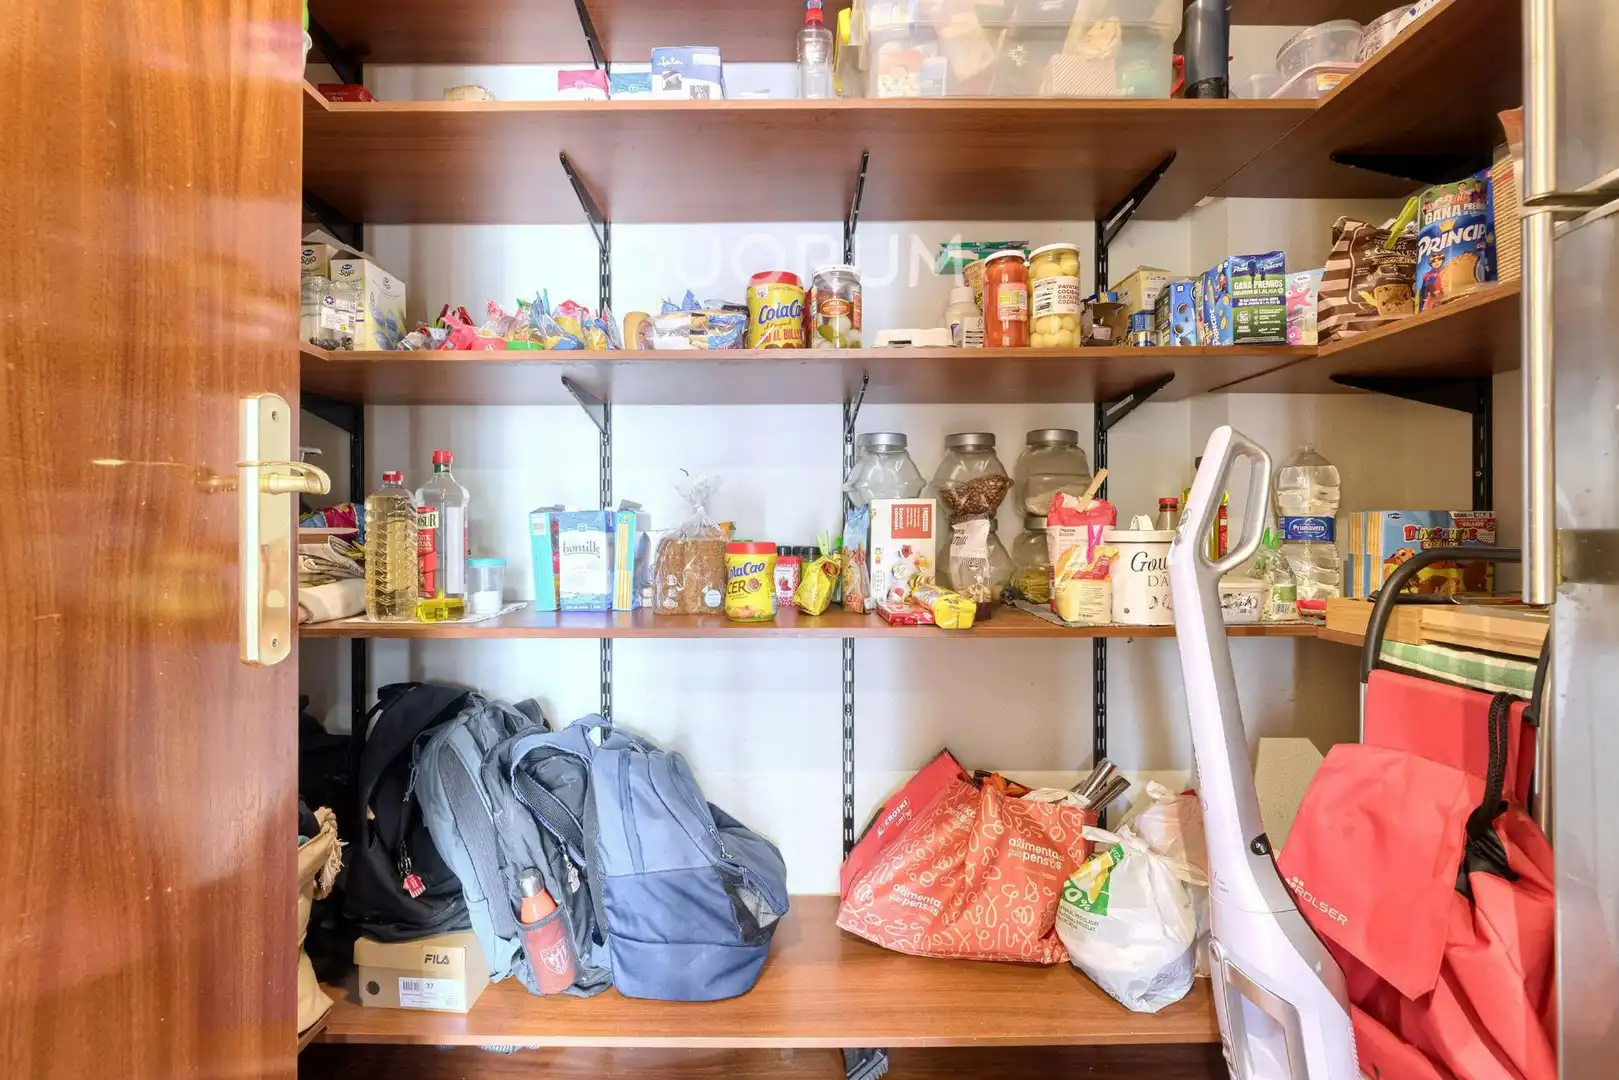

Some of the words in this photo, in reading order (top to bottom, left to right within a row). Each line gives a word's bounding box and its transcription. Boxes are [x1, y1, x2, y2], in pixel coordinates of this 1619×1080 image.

[1425, 204, 1462, 226] GANA
[1417, 223, 1487, 263] PRINCIP
[758, 298, 804, 325] ColaCa
[728, 561, 766, 579] olaCao
[883, 798, 909, 826] EROSKI
[1008, 837, 1059, 860] alimenta
[893, 883, 942, 907] alimenta
[1294, 884, 1348, 926] ROLSER
[424, 954, 450, 965] FILA
